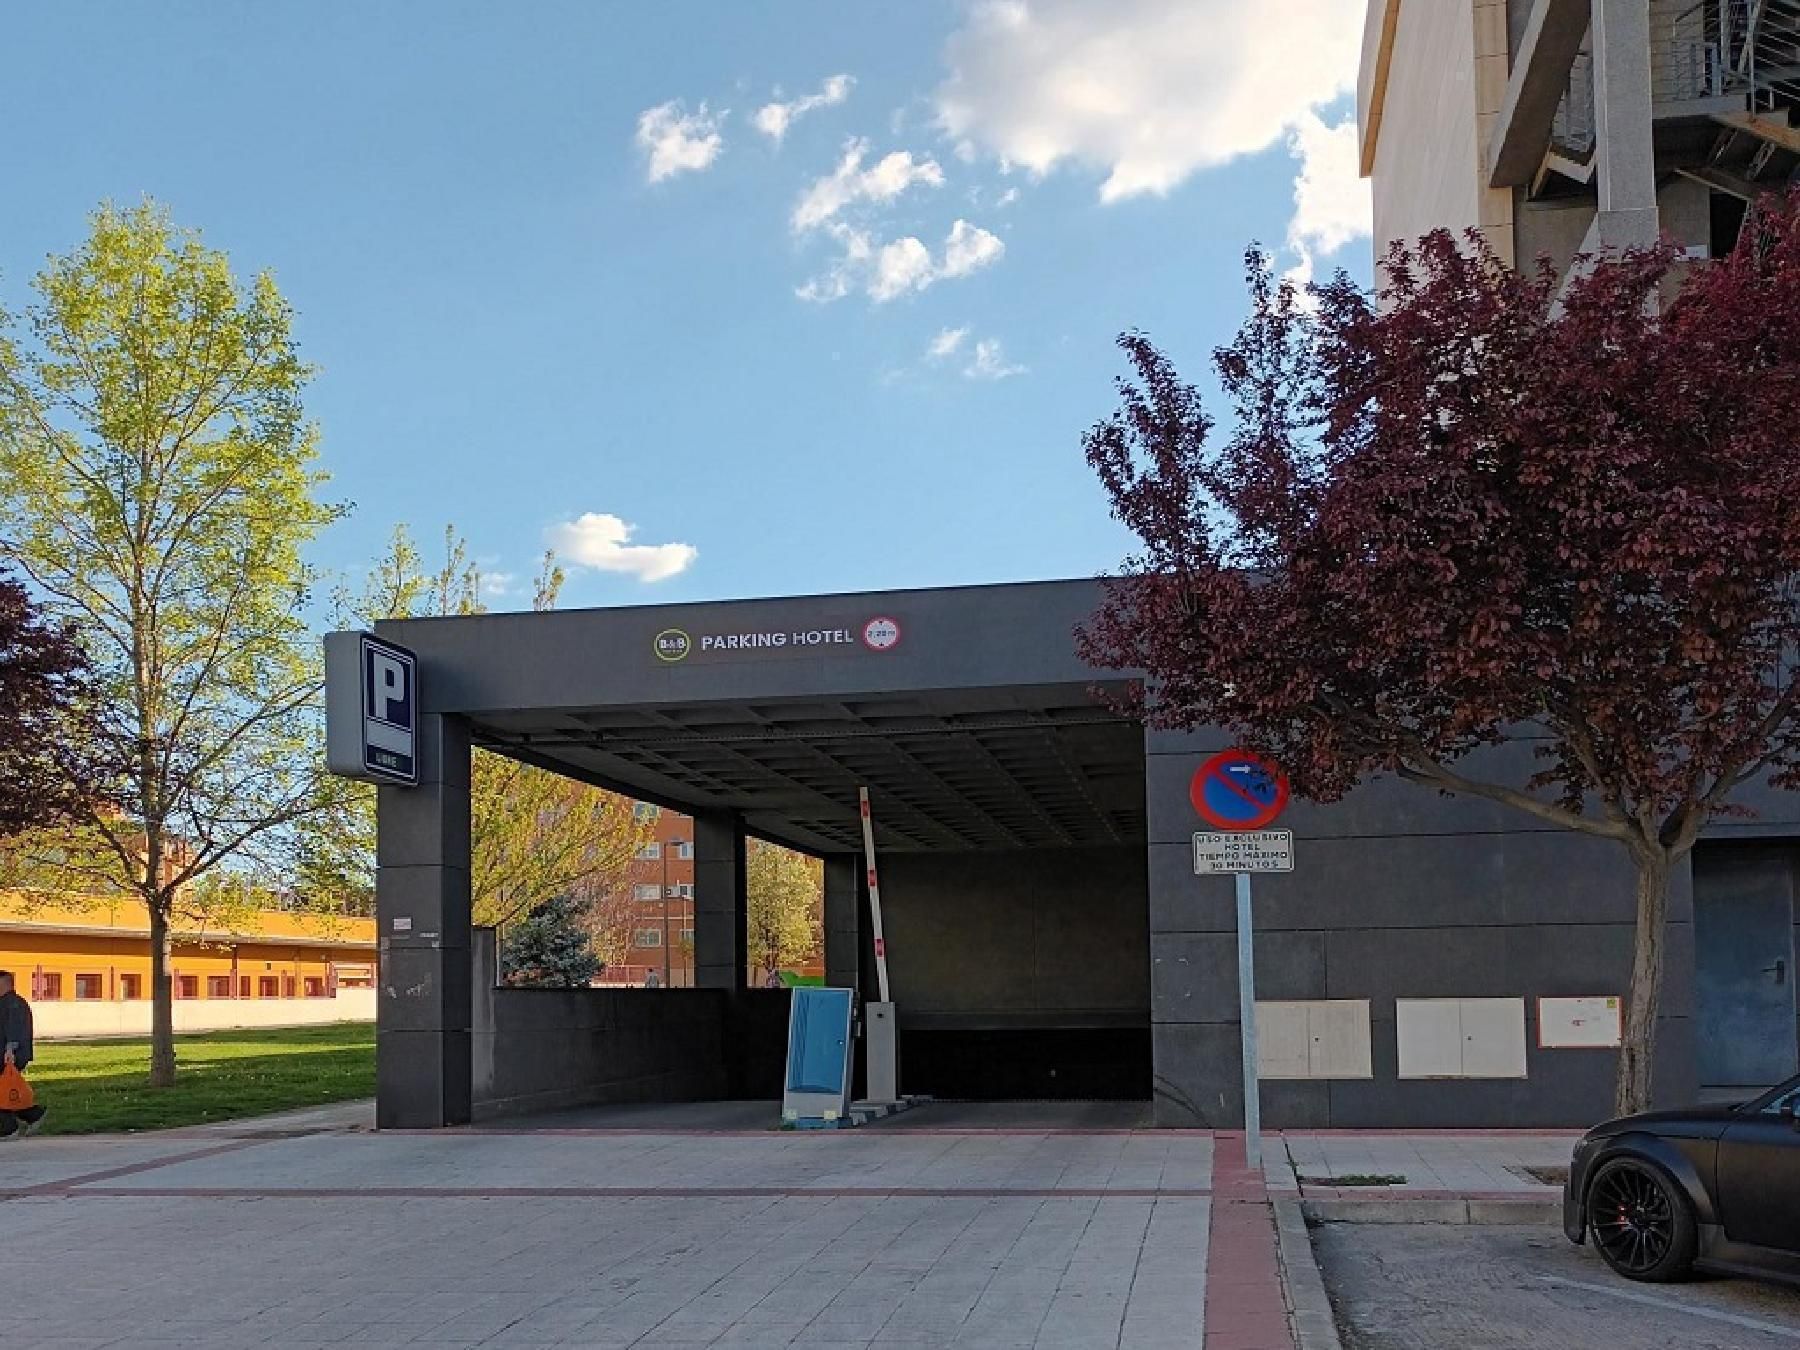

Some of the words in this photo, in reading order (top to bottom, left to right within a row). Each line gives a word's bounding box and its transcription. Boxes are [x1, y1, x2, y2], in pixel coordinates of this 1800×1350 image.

[701, 632, 787, 650] PARKING
[792, 629, 854, 645] HOTEL
[373, 652, 405, 721] P
[1224, 843, 1261, 851] HOTEL
[1199, 852, 1240, 861] TIEMPO
[1226, 861, 1279, 869] MINUTOS
